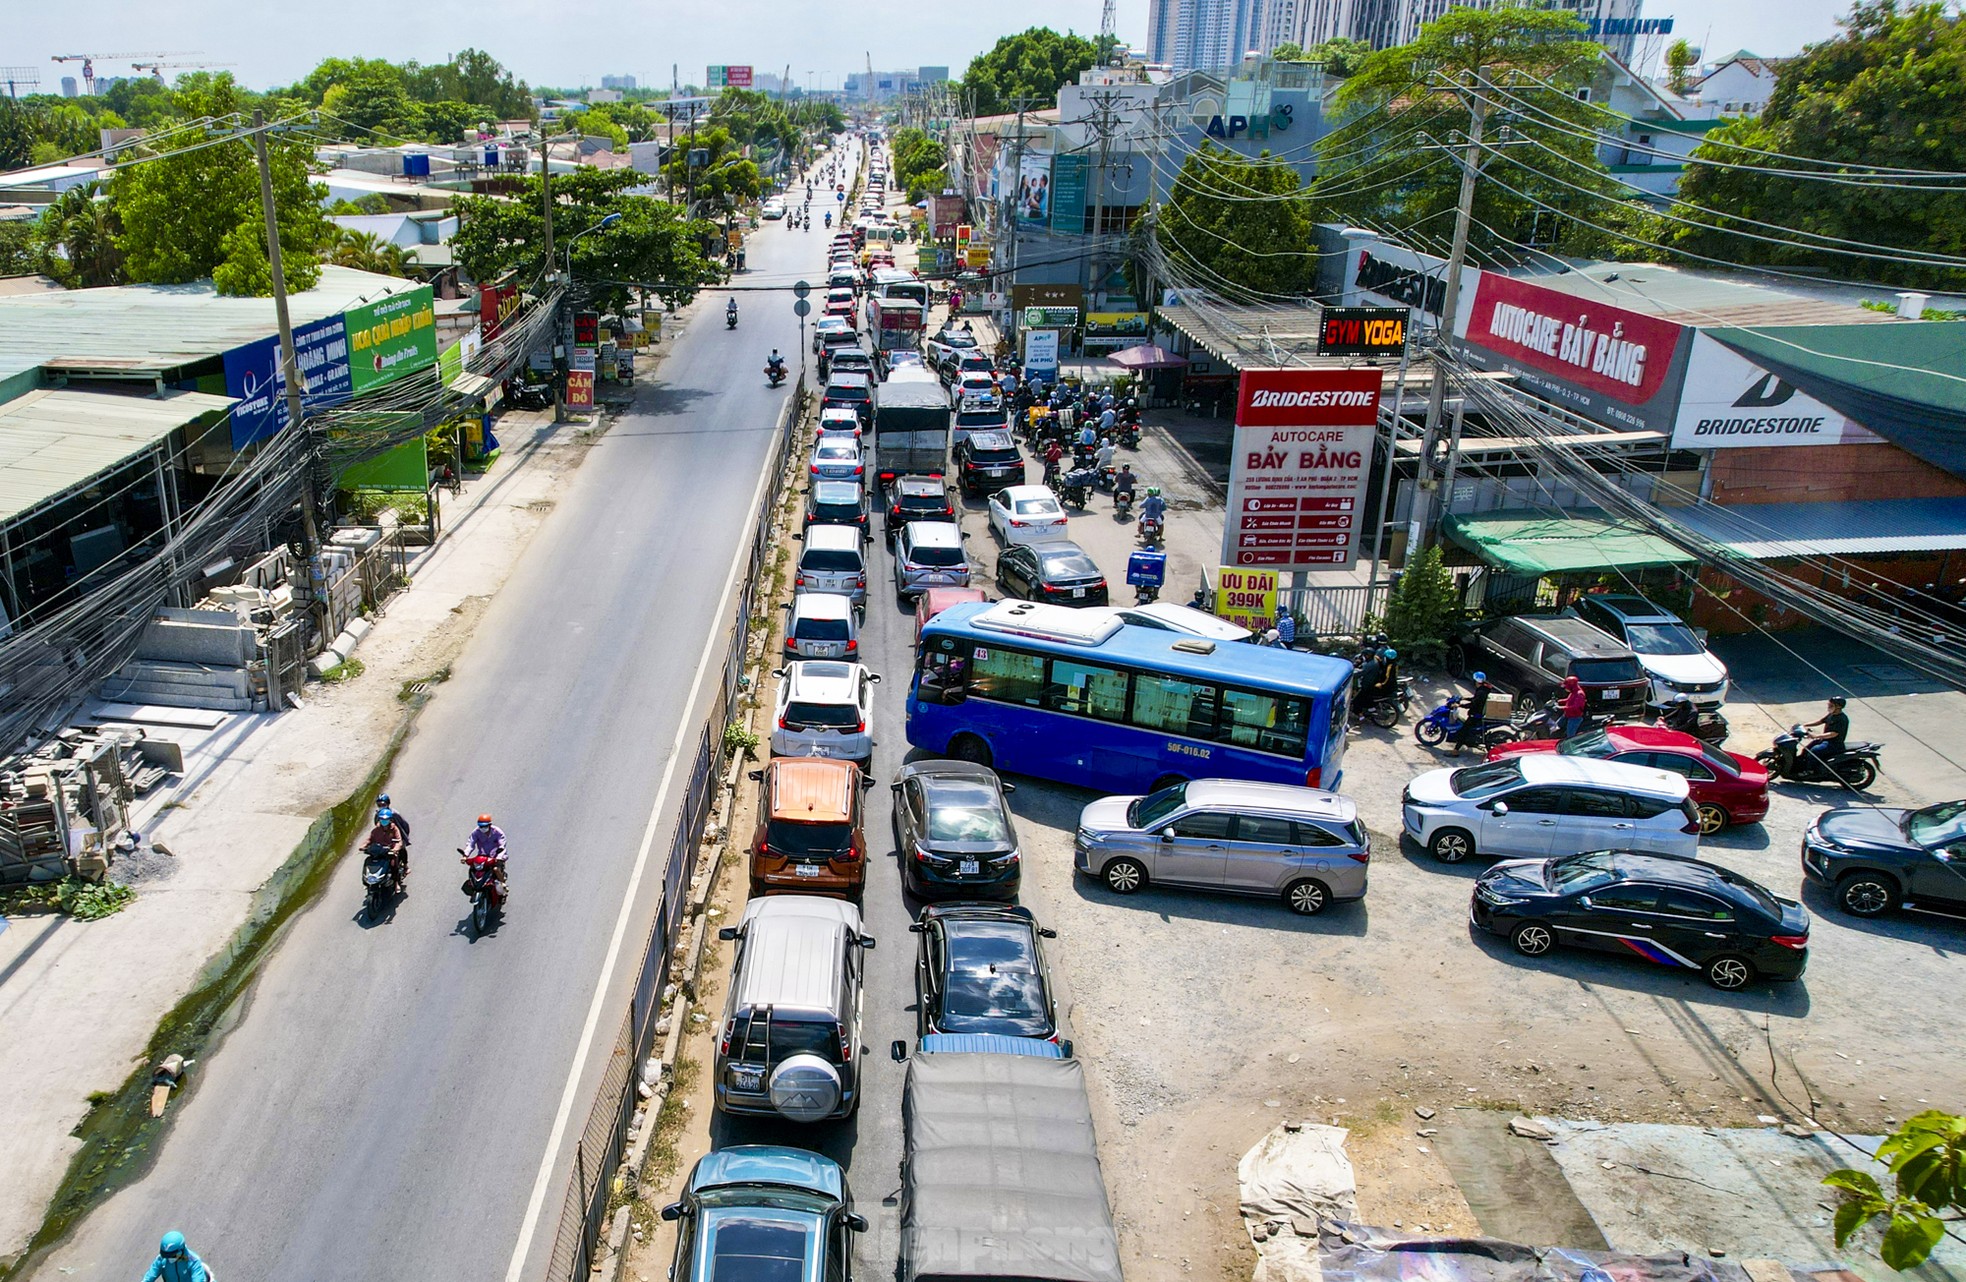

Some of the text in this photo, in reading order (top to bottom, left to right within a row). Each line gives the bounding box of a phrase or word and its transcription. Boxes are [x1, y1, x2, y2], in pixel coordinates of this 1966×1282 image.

[1205, 115, 1270, 138] APH
[352, 329, 372, 352] HOA
[1326, 319, 1402, 346] GYM YOGA
[1489, 301, 1647, 387] AUTOCARE BẢY BẰNG
[297, 338, 347, 372] HOÀNG MINH
[1251, 390, 1375, 408] BRIDGESTONE
[1580, 395, 1591, 406] HCM
[1694, 417, 1825, 436] BRIDGESTONE
[1271, 431, 1344, 442] AUTOCARE
[1247, 443, 1362, 469] BẢY BẰNG
[1222, 573, 1273, 592] ƯU ĐÃI
[1226, 592, 1266, 608] 399K
[976, 649, 986, 659] 43
[1168, 742, 1210, 760] 50F-016.02
